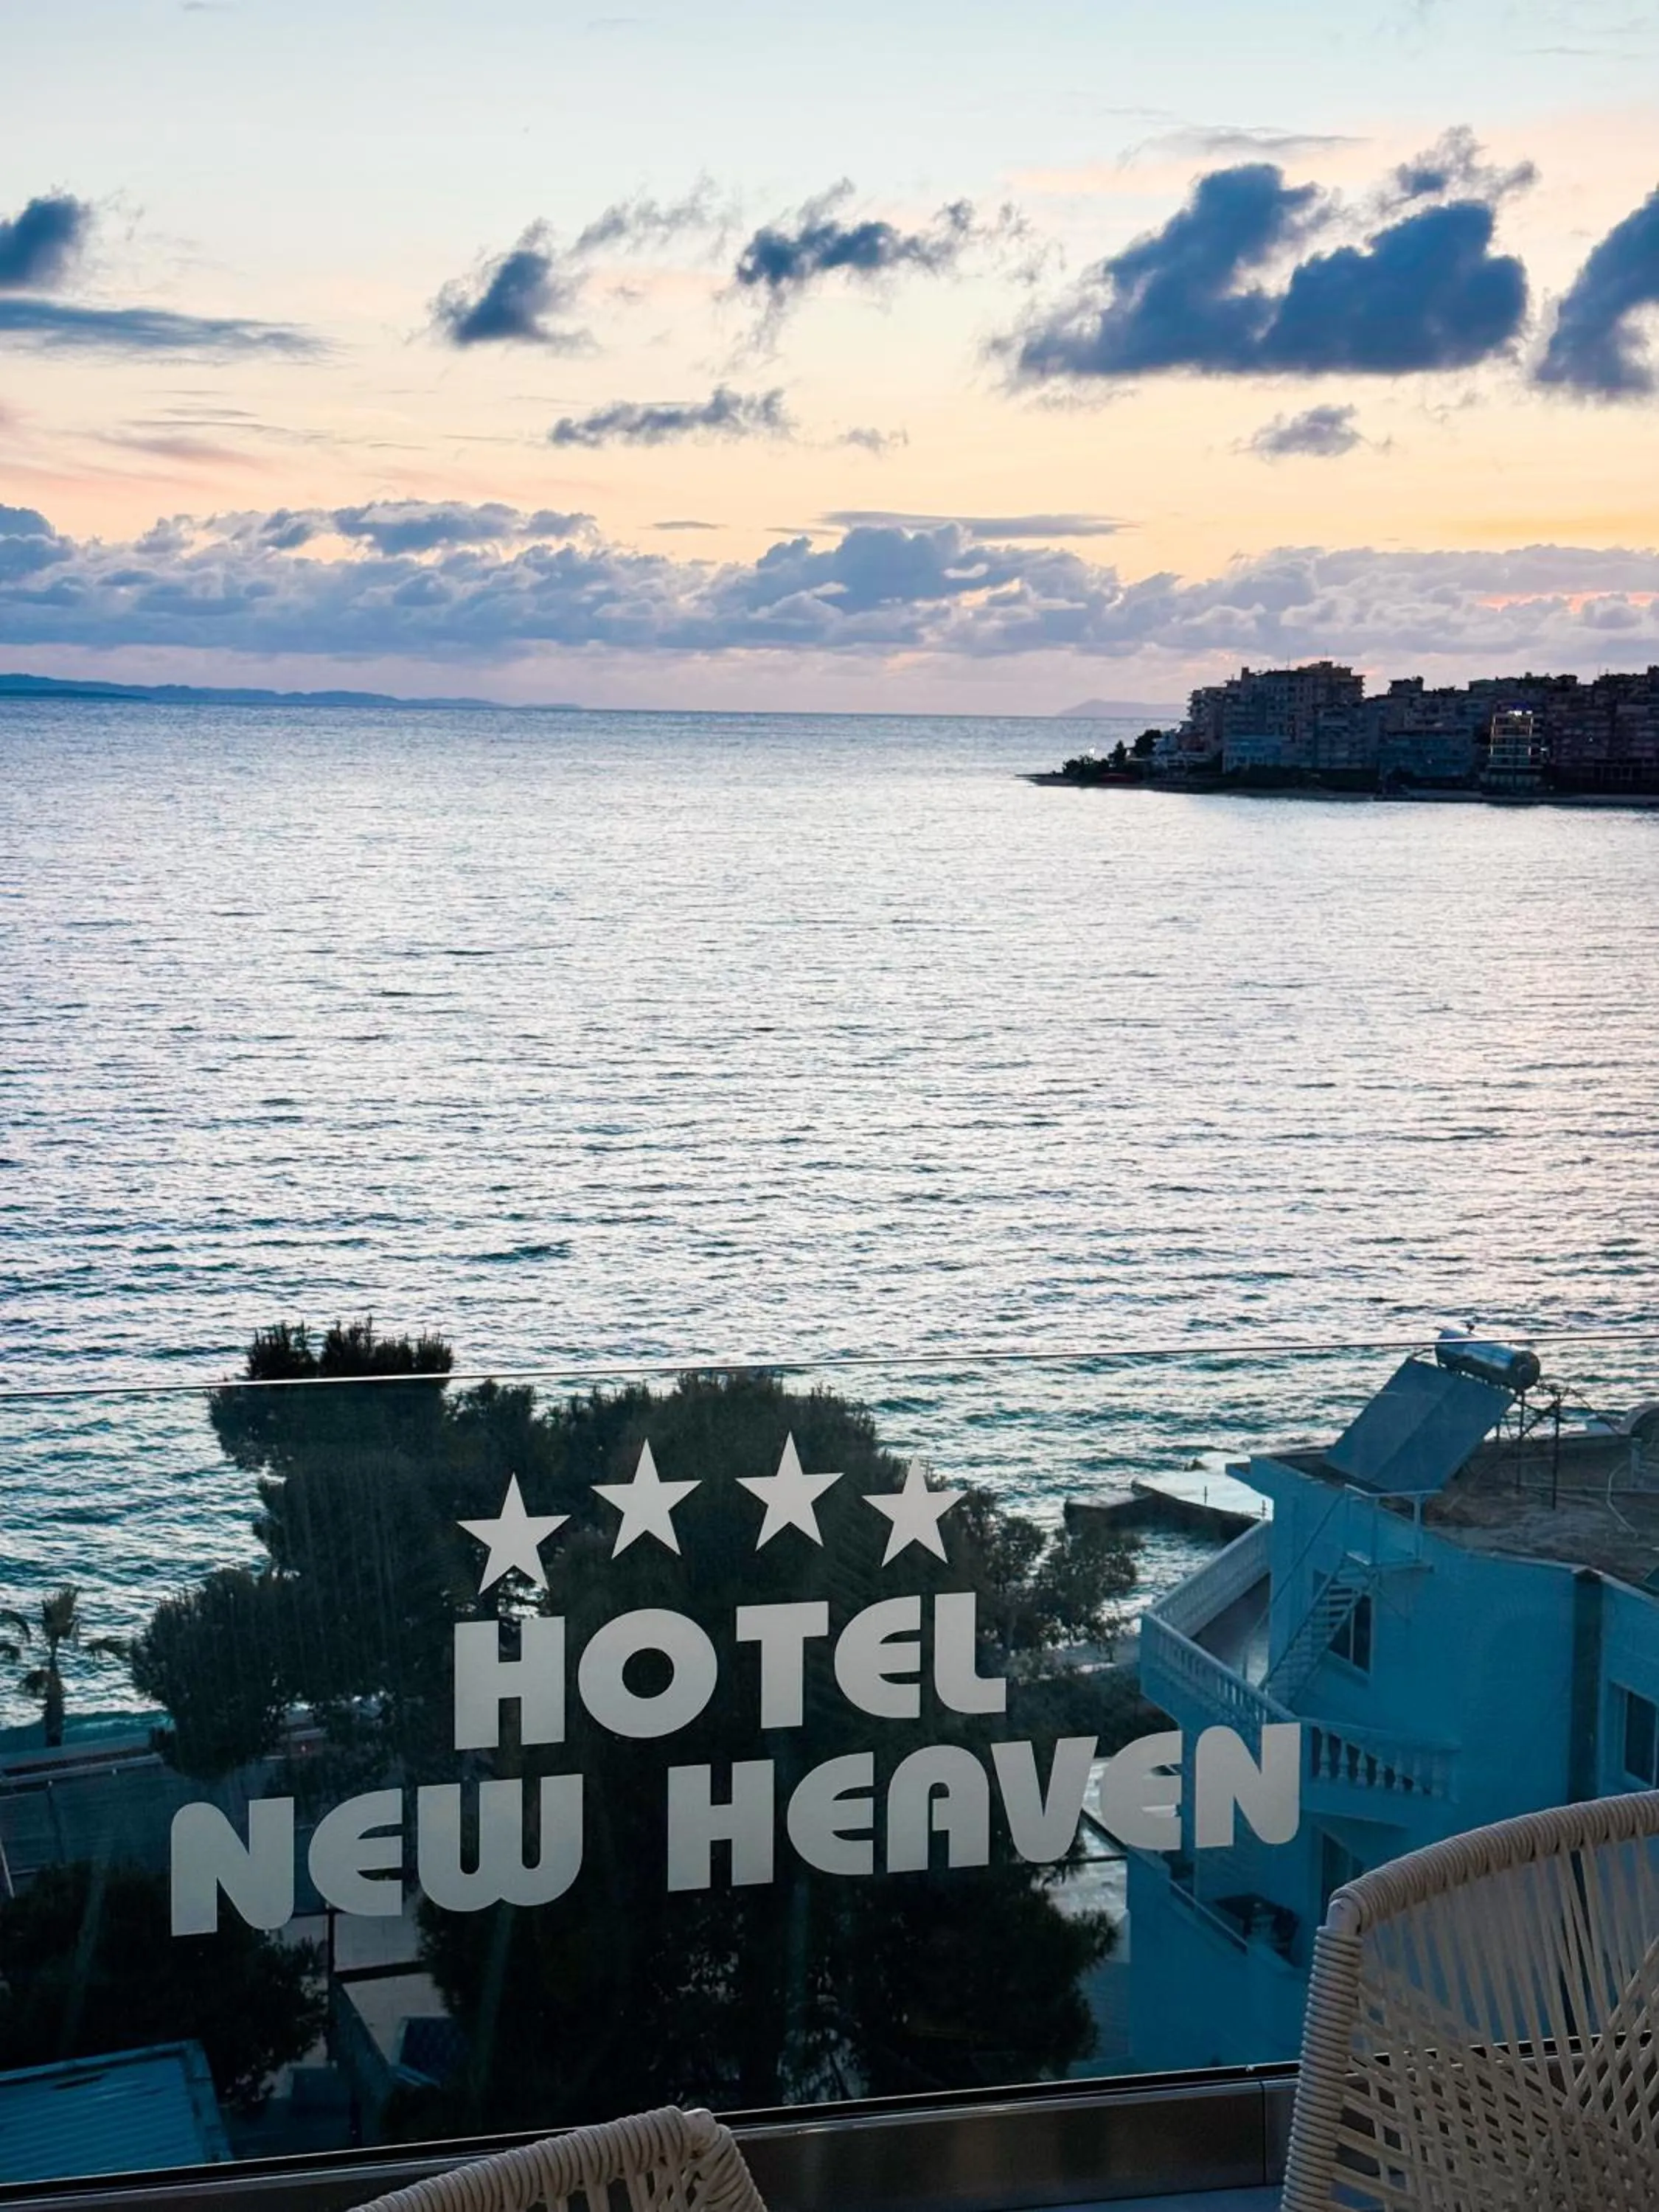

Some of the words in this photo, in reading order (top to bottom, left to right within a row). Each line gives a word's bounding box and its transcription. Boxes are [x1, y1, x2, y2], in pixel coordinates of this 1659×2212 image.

[454, 1592, 1006, 1750] HOTEL
[170, 1773, 583, 1937] NEW
[667, 1722, 1301, 1892] HEAVEN
